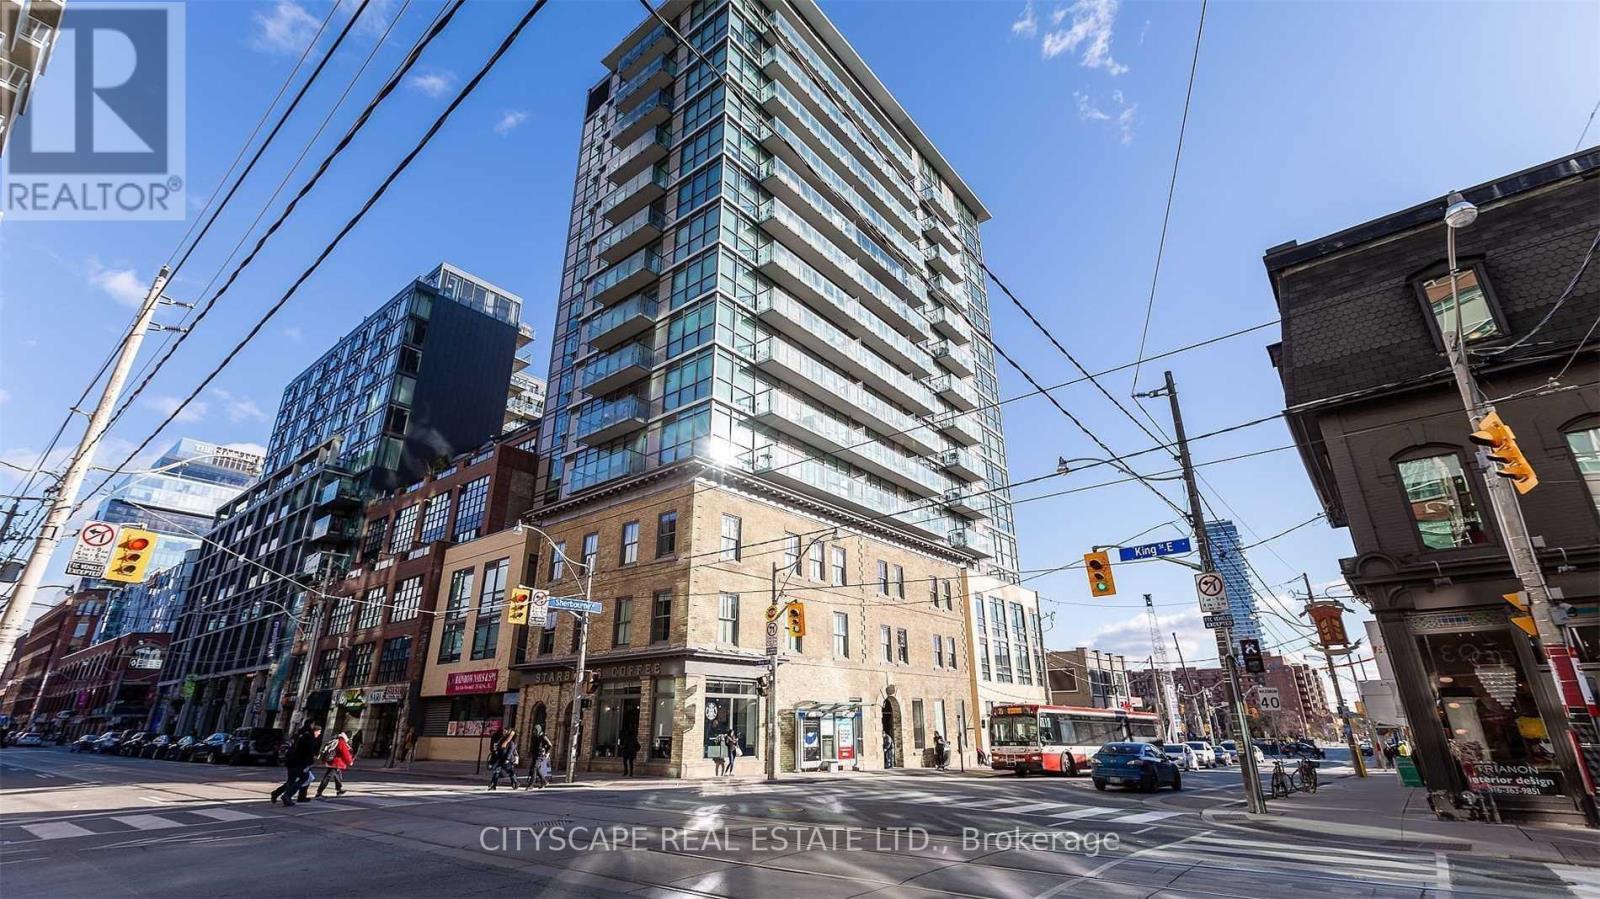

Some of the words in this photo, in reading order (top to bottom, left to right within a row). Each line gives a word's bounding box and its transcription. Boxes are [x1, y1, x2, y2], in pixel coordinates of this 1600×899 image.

[1135, 546, 1157, 557] King
[1167, 542, 1174, 551] E
[535, 668, 601, 683] STARBS
[612, 663, 660, 677] COFFEE
[1261, 696, 1280, 709] 40
[1474, 764, 1539, 774] TRIANON
[1516, 776, 1555, 788] design
[1486, 786, 1541, 795] 16-363-9851
